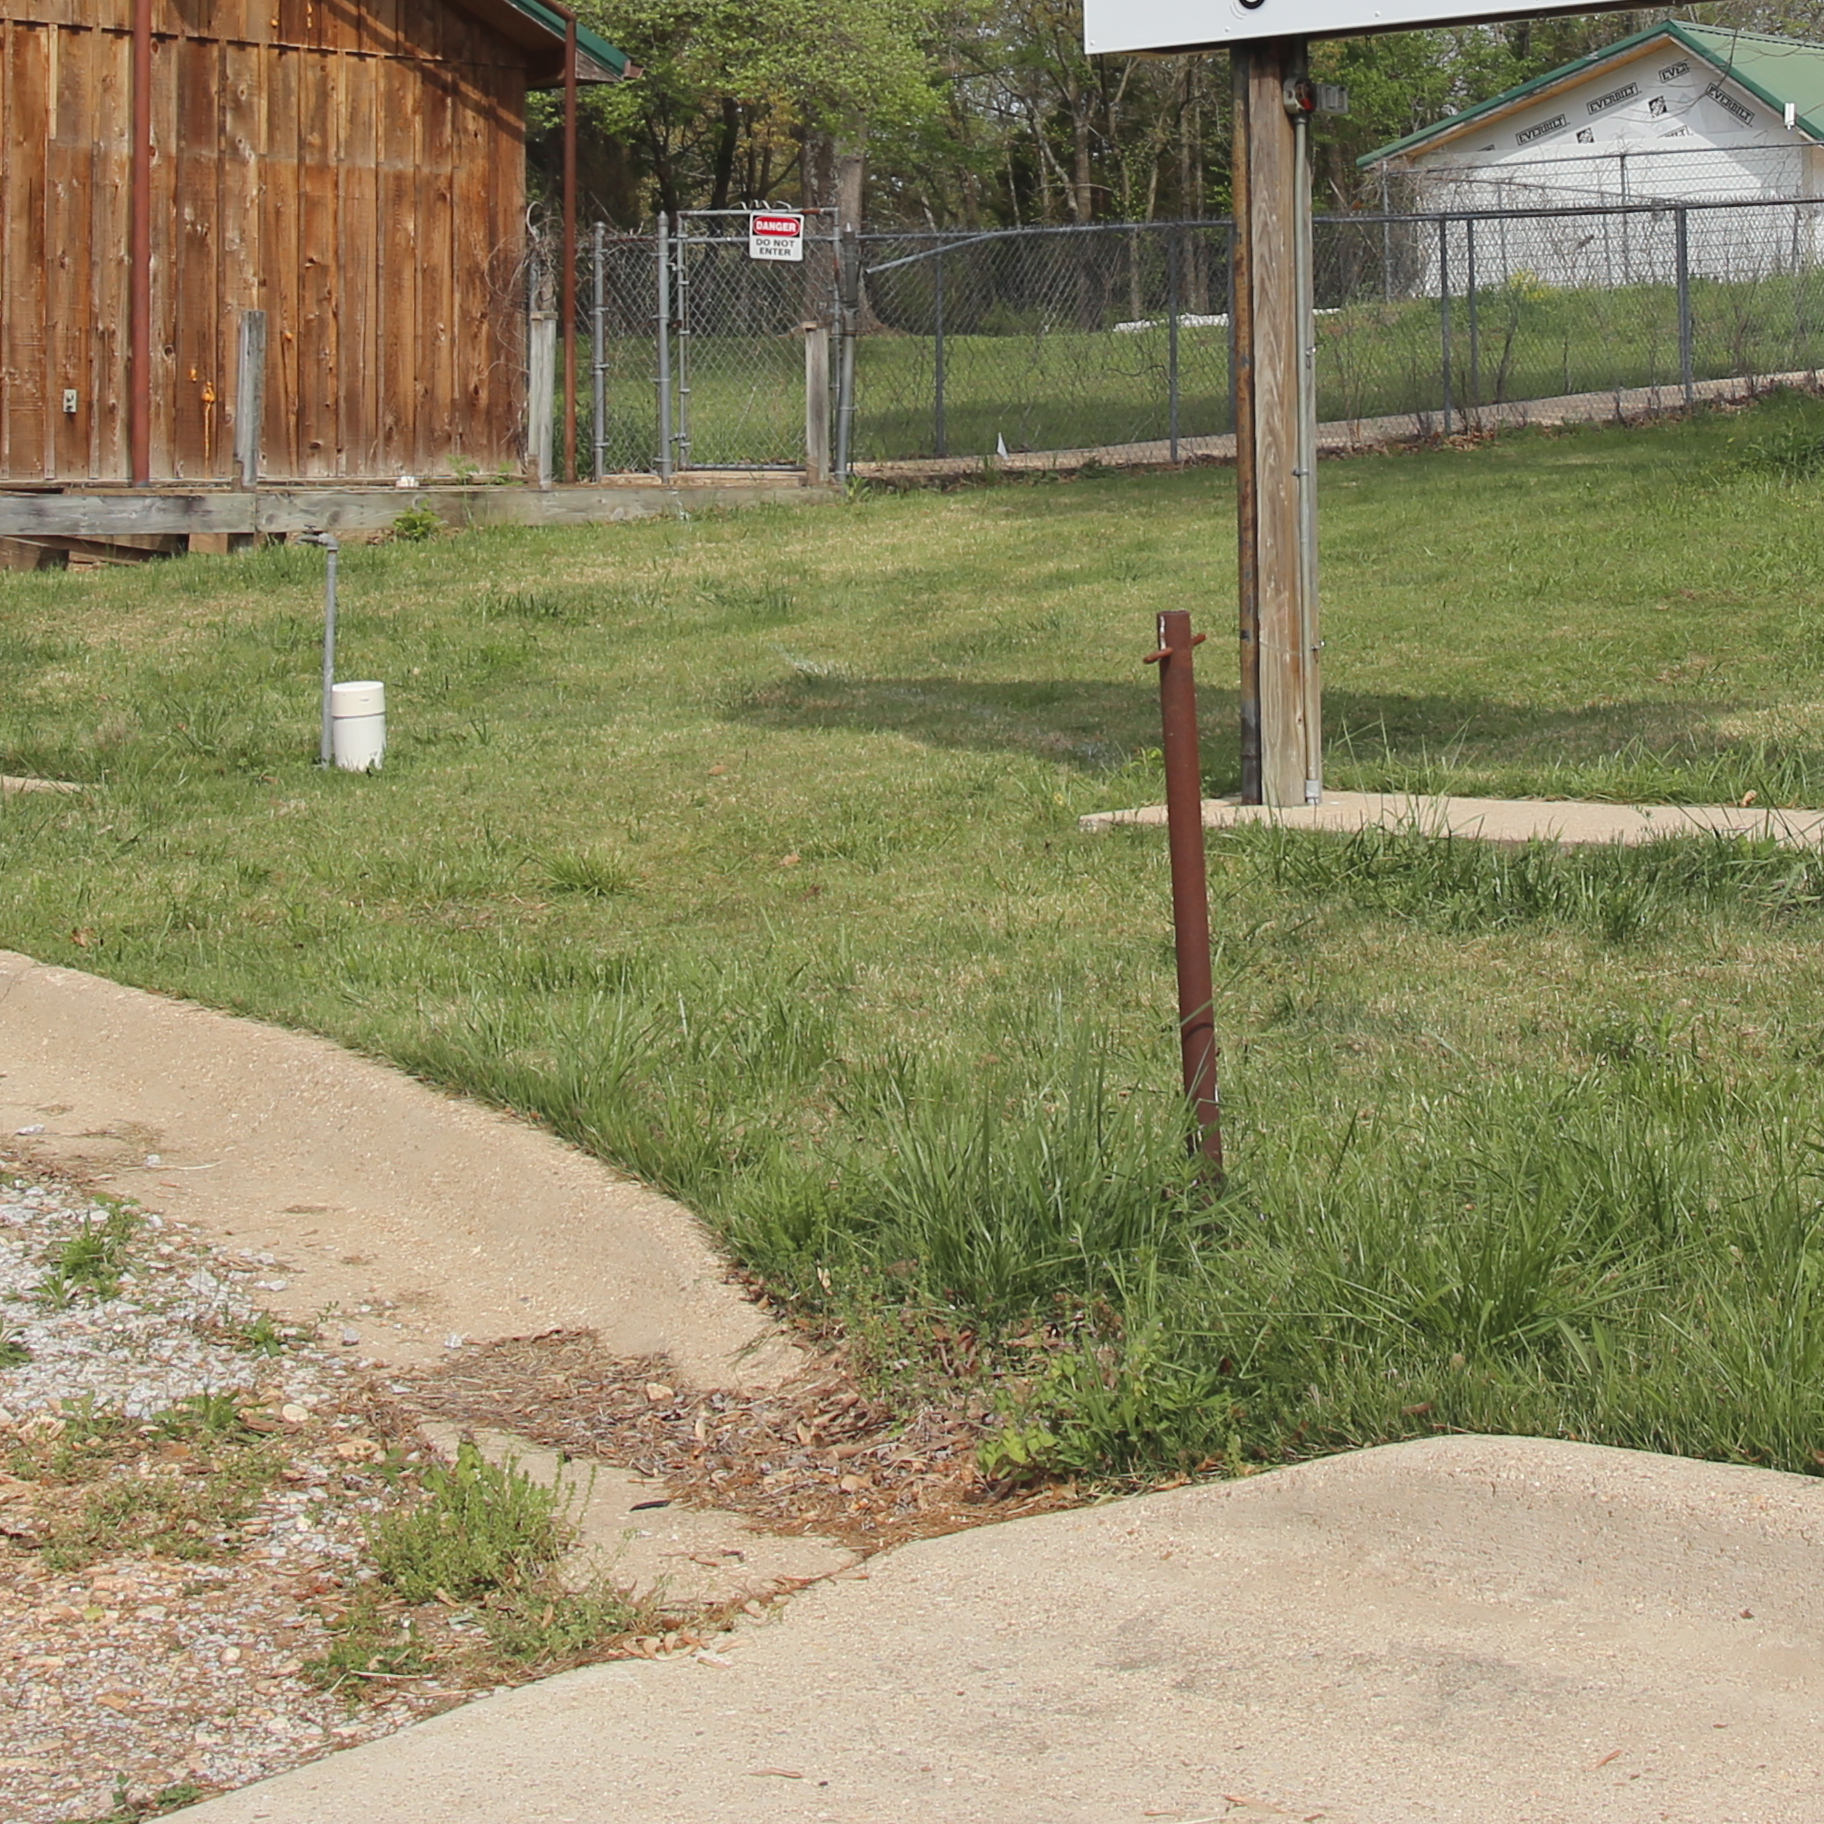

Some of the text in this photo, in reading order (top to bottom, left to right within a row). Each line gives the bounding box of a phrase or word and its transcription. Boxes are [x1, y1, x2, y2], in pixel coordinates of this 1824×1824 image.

[1588, 83, 1637, 114] EVERBILT
[1707, 84, 1754, 124] EVERBILT
[1517, 114, 1566, 144] EVERBILT
[756, 220, 796, 232] DANGER
[756, 238, 795, 247] DO NOT
[759, 247, 792, 256] ENTER
